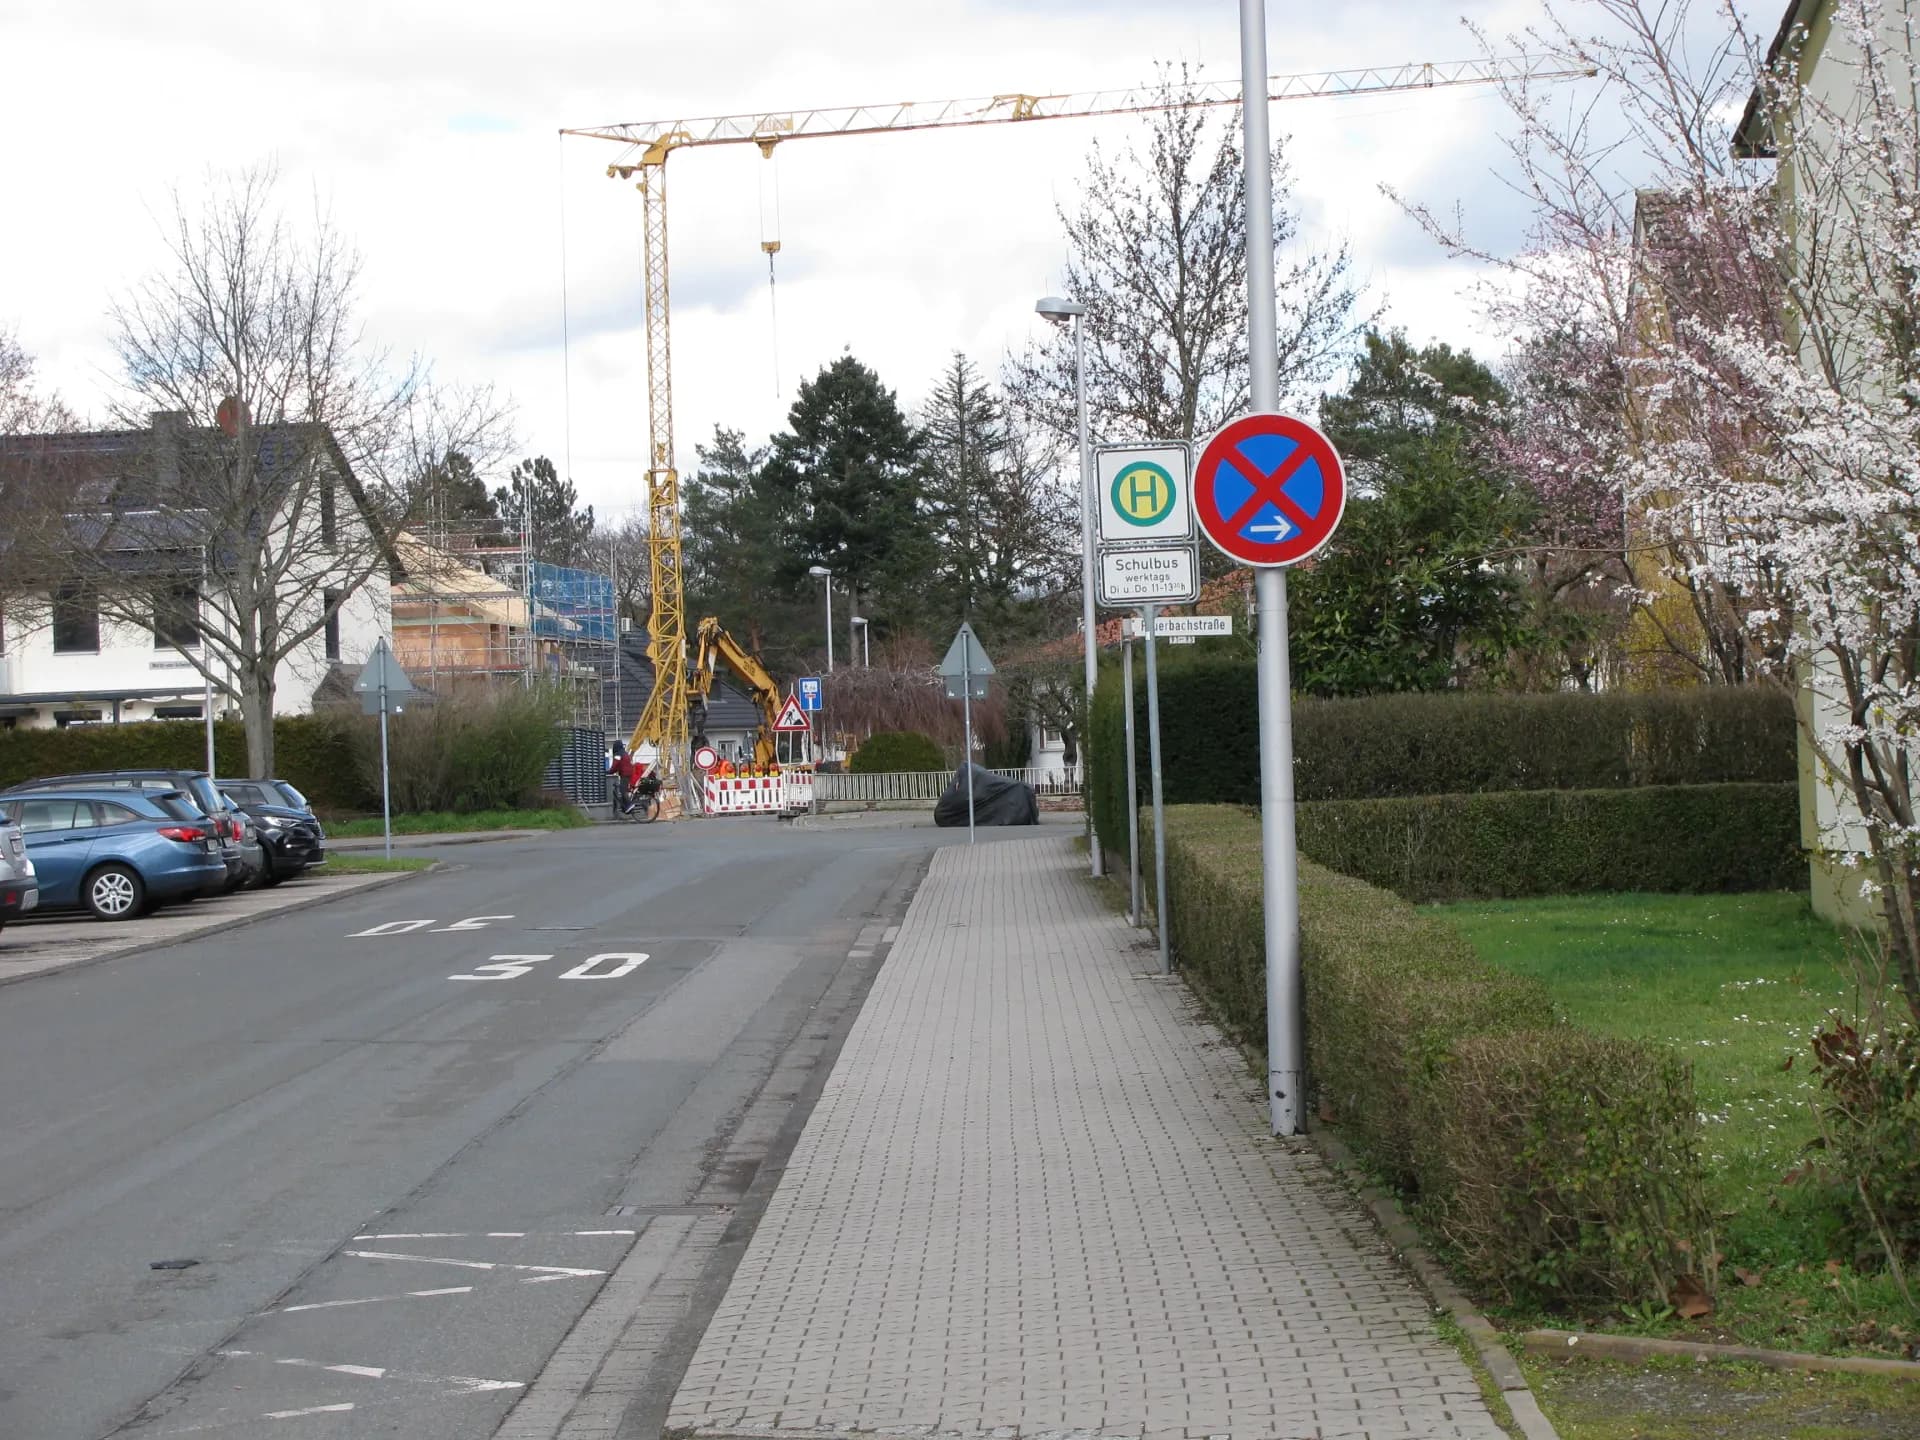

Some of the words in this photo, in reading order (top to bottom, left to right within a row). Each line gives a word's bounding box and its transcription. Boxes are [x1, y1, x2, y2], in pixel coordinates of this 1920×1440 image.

[1129, 475, 1158, 513] H
[1115, 557, 1179, 571] Schulbus
[1125, 573, 1170, 583] werktags
[1110, 585, 1120, 594] Di
[1135, 584, 1148, 593] Do
[447, 952, 651, 980] 30
